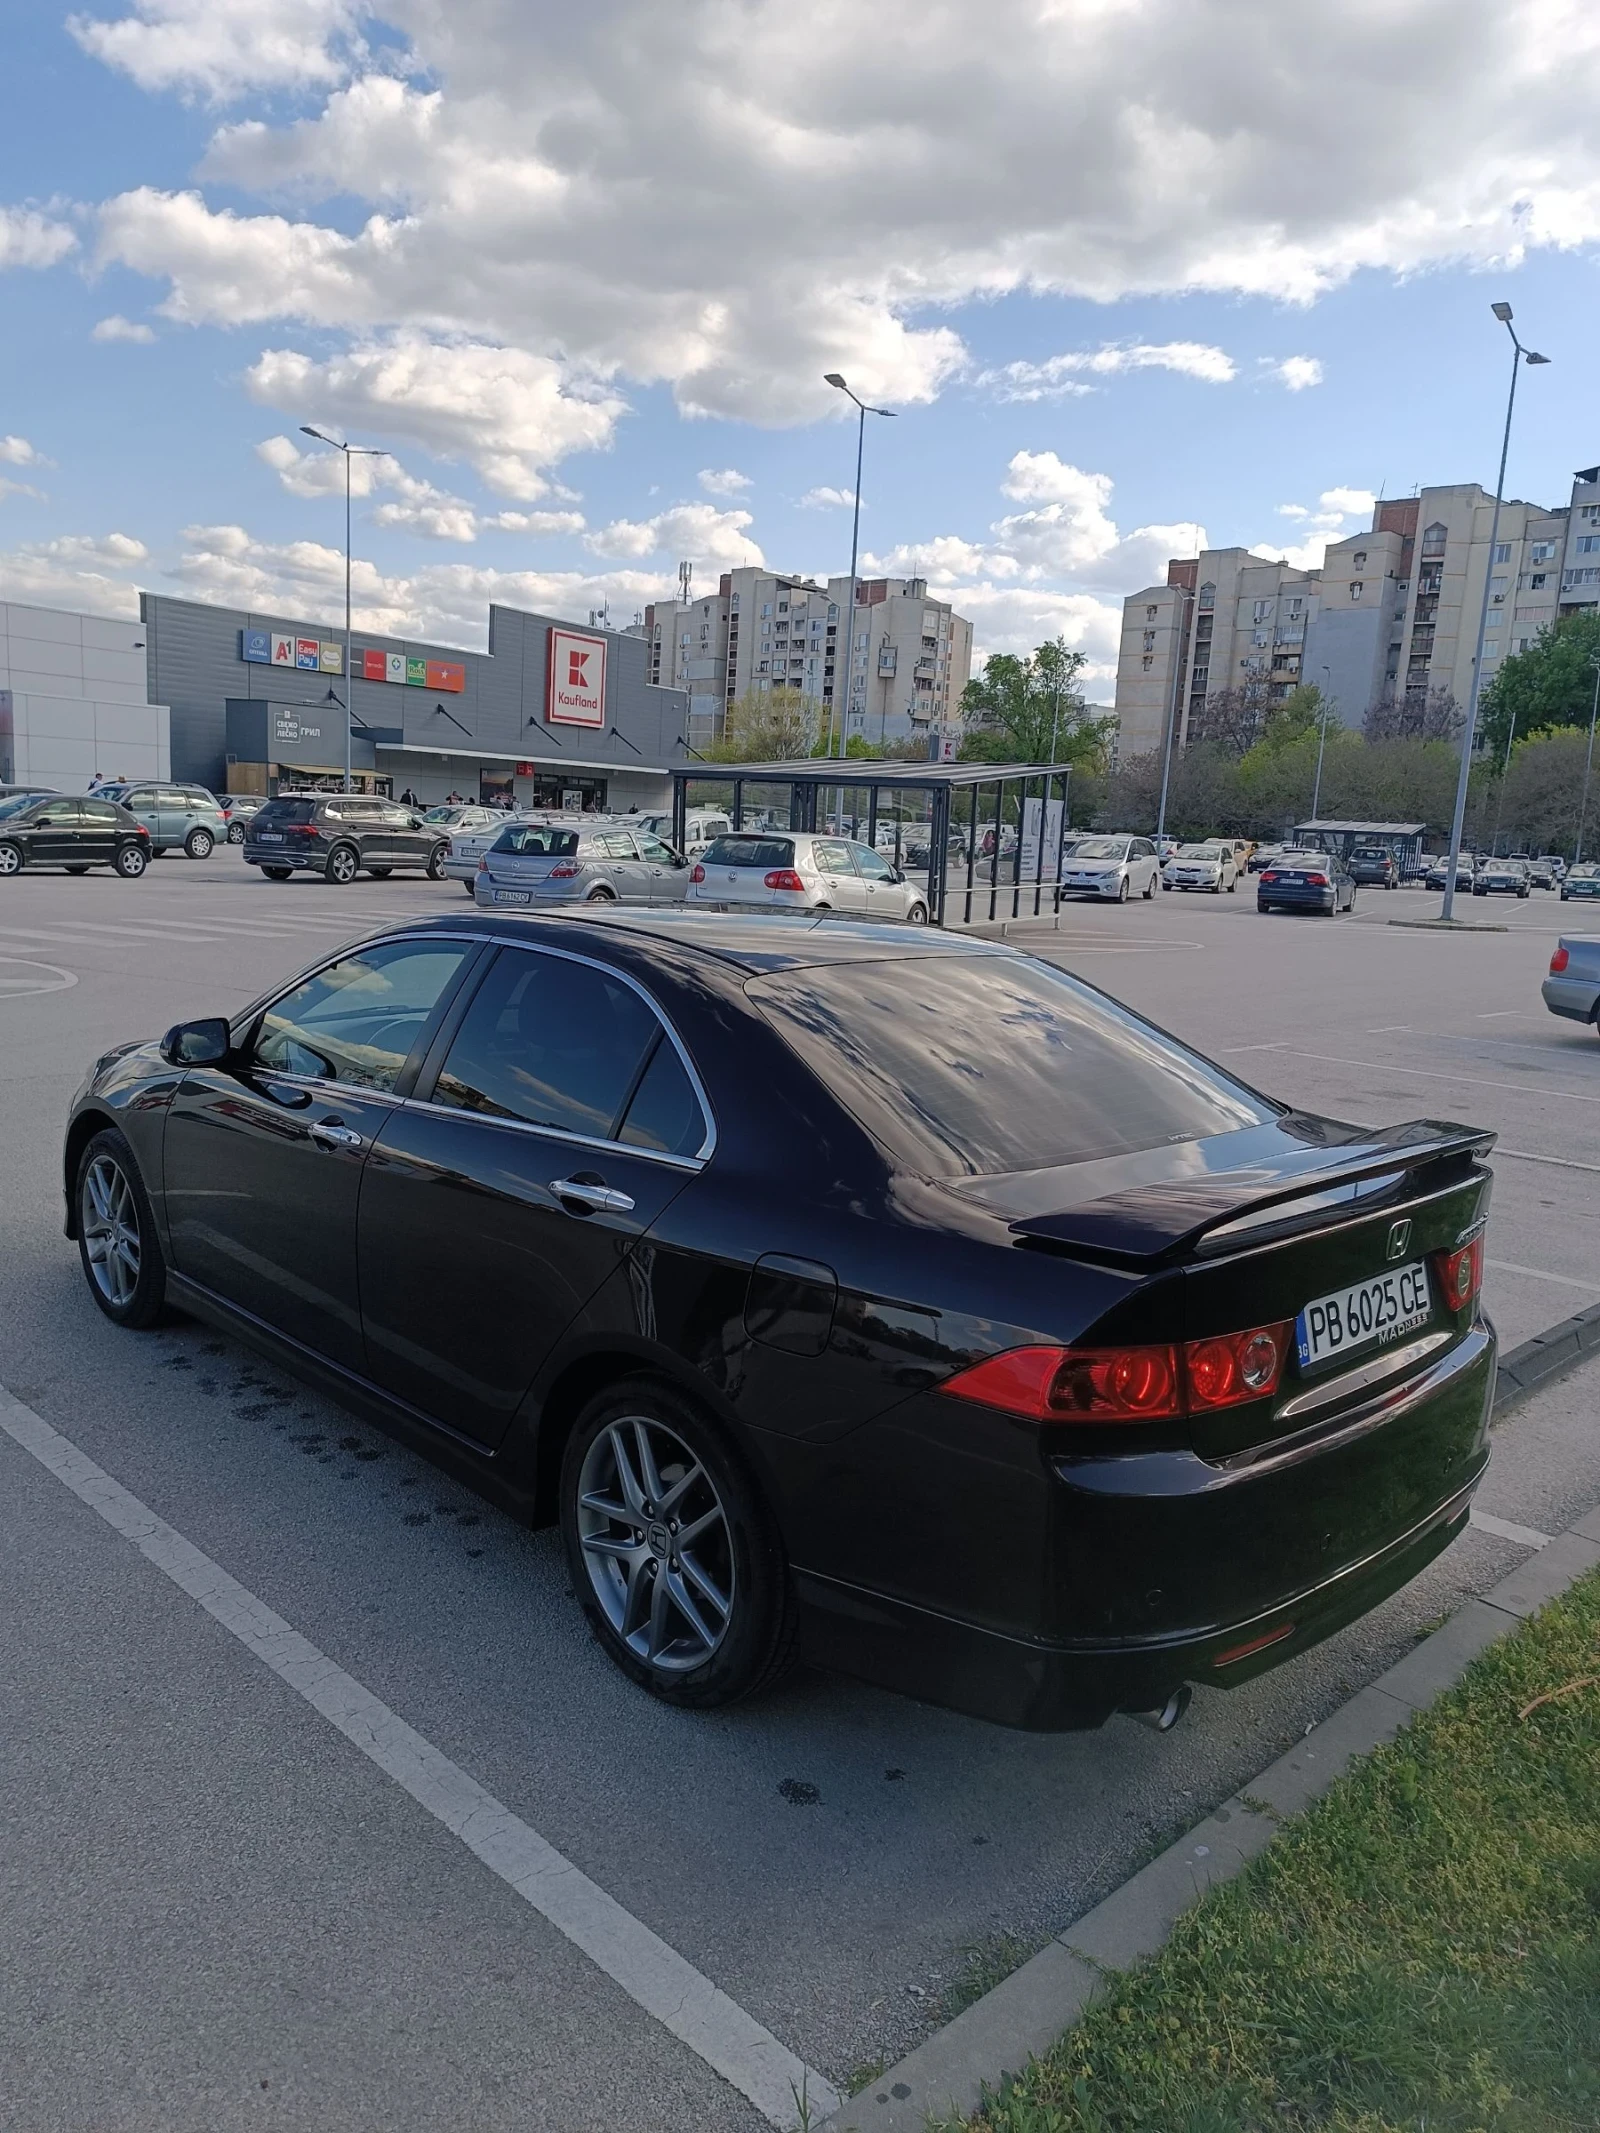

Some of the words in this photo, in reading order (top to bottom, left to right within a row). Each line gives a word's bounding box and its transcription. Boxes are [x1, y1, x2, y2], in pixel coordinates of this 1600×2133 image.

[275, 640, 292, 660] A1
[298, 644, 317, 657] Easy
[298, 654, 314, 667] Pay
[558, 691, 598, 709] Kaufland
[300, 727, 321, 738] ГРИЛ
[1347, 1278, 1398, 1338] 6025
[1399, 1267, 1428, 1315] CE
[1377, 1312, 1429, 1345] MADNESS
